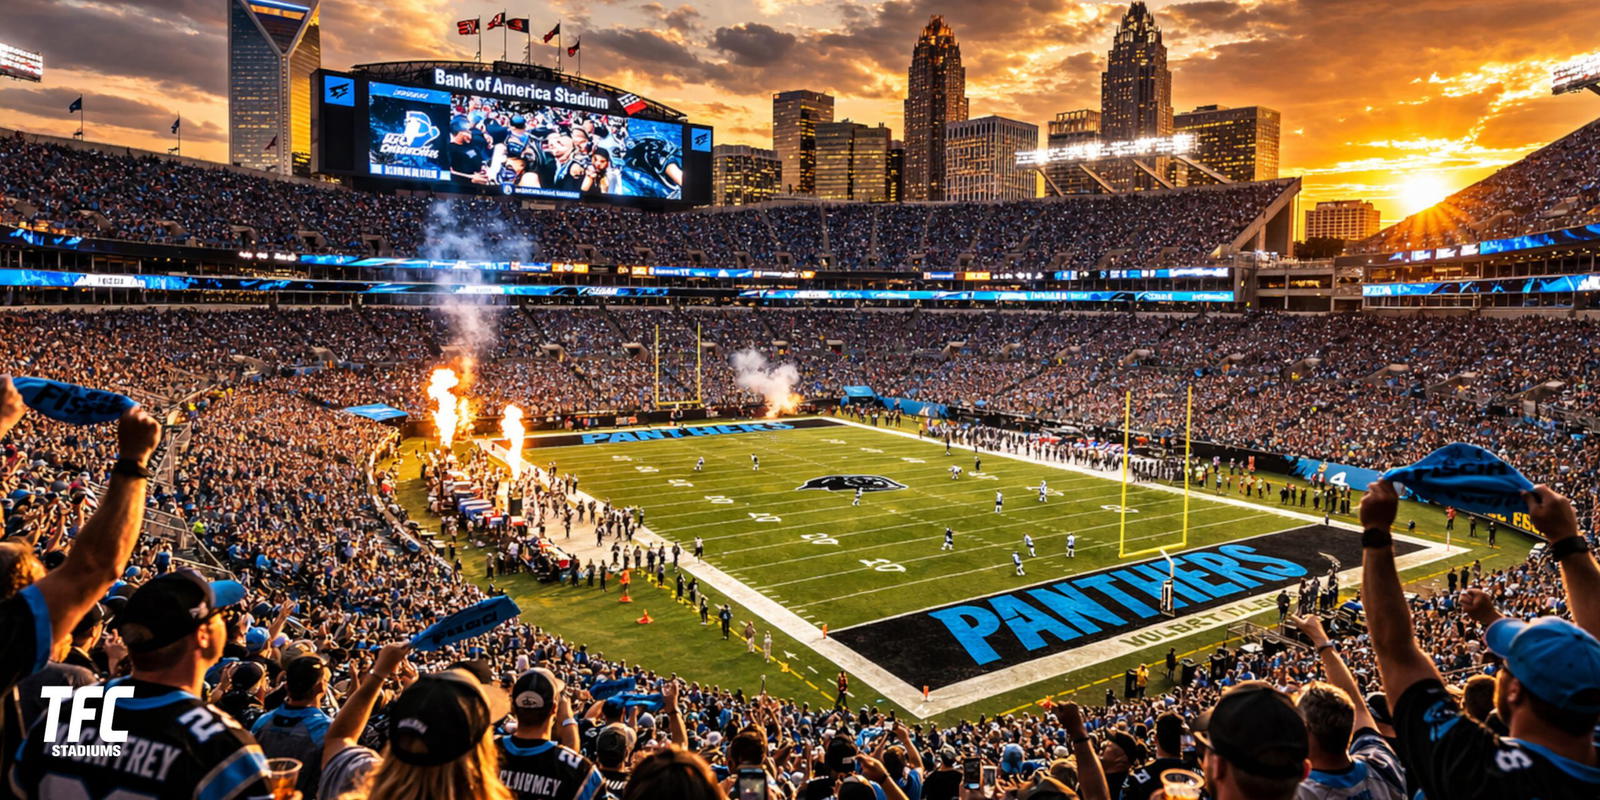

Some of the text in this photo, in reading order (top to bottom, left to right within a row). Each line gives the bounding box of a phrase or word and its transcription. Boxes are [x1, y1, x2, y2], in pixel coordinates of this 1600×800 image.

[435, 68, 609, 109] Bank of America Stadium
[581, 422, 795, 445] PANTHERS
[928, 544, 1308, 667] PANTHERS
